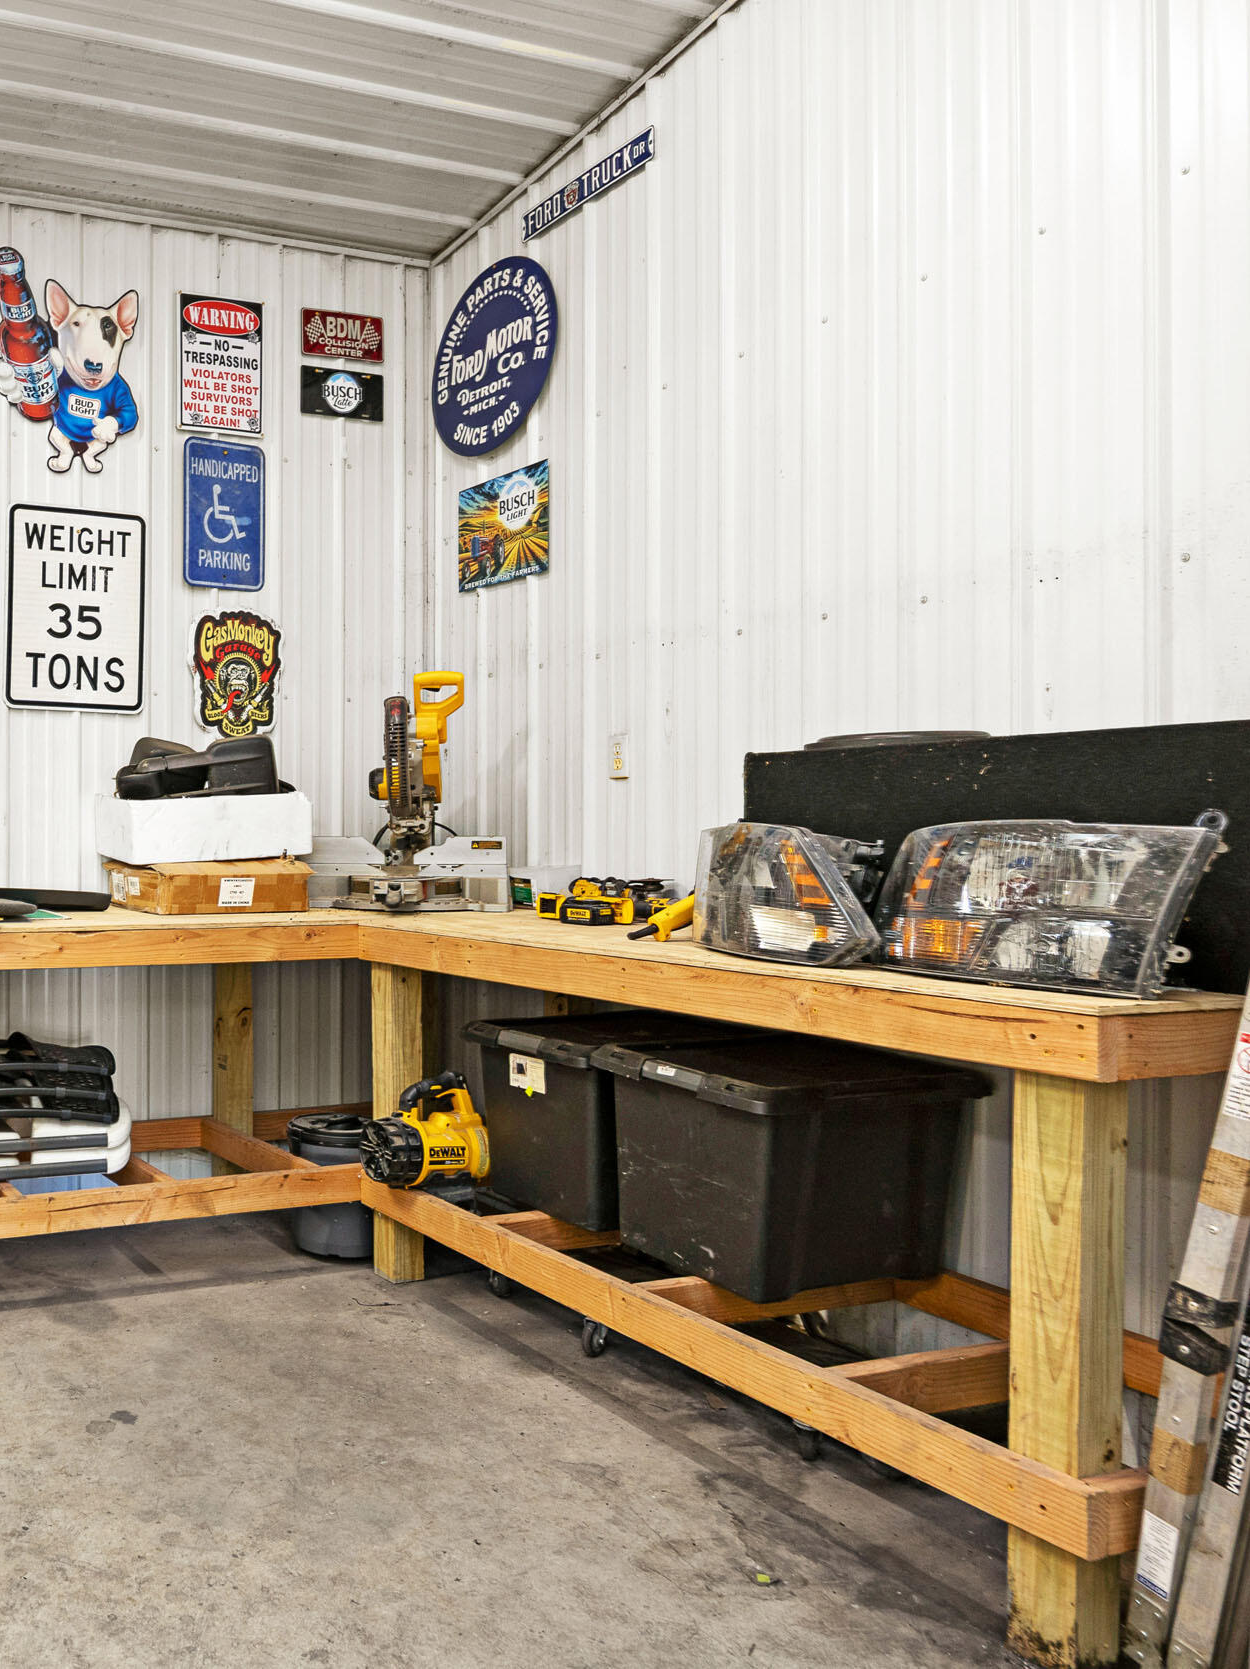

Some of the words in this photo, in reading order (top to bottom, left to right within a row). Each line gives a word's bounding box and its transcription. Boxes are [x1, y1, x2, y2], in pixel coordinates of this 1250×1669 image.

[528, 193, 561, 235] FORD
[582, 144, 632, 197] TRUCK
[633, 141, 645, 159] DR
[8, 310, 31, 319] LIGHT
[10, 305, 29, 313] BUD
[189, 305, 255, 331] WARNING
[326, 316, 361, 340] BDM
[438, 311, 467, 405] GENUINE
[466, 269, 511, 313] PARTS
[513, 268, 524, 288] &
[524, 275, 550, 360] SERVICE
[214, 339, 230, 352] NO
[318, 337, 369, 350] COLLISION
[325, 346, 363, 357] CENTER
[451, 350, 487, 386] FORD
[485, 316, 533, 360] MOTOR
[184, 350, 258, 370] TRESPASSING
[498, 351, 525, 374] CO.
[191, 368, 252, 384] VIOLATORS
[23, 381, 50, 393] BUD
[183, 379, 210, 390] WILL
[213, 382, 227, 392] BE
[231, 384, 259, 396] SHOT
[323, 384, 362, 401] BUSCH
[457, 376, 512, 406] DETROIT,
[74, 398, 94, 409] BUD
[191, 391, 252, 406] SURVIVORS
[70, 405, 97, 416] LIGHT
[183, 402, 210, 413] WILL
[213, 405, 227, 415] BE
[231, 407, 259, 418] SHOT
[203, 415, 240, 428] AGAIN!
[454, 423, 488, 446] SINCE
[492, 401, 520, 437] 1903
[191, 457, 259, 483] HANDICAPPED
[499, 490, 535, 516] BUSCH
[507, 508, 528, 521] LIGHT
[24, 522, 131, 558] WEIGHT
[198, 549, 251, 571] PARKING
[41, 561, 113, 593] LIMIT
[46, 603, 102, 640] 35
[215, 643, 261, 662] Garage
[26, 651, 125, 693] TONS
[225, 724, 251, 735] SWEAT
[1223, 1379, 1245, 1432] STOOL
